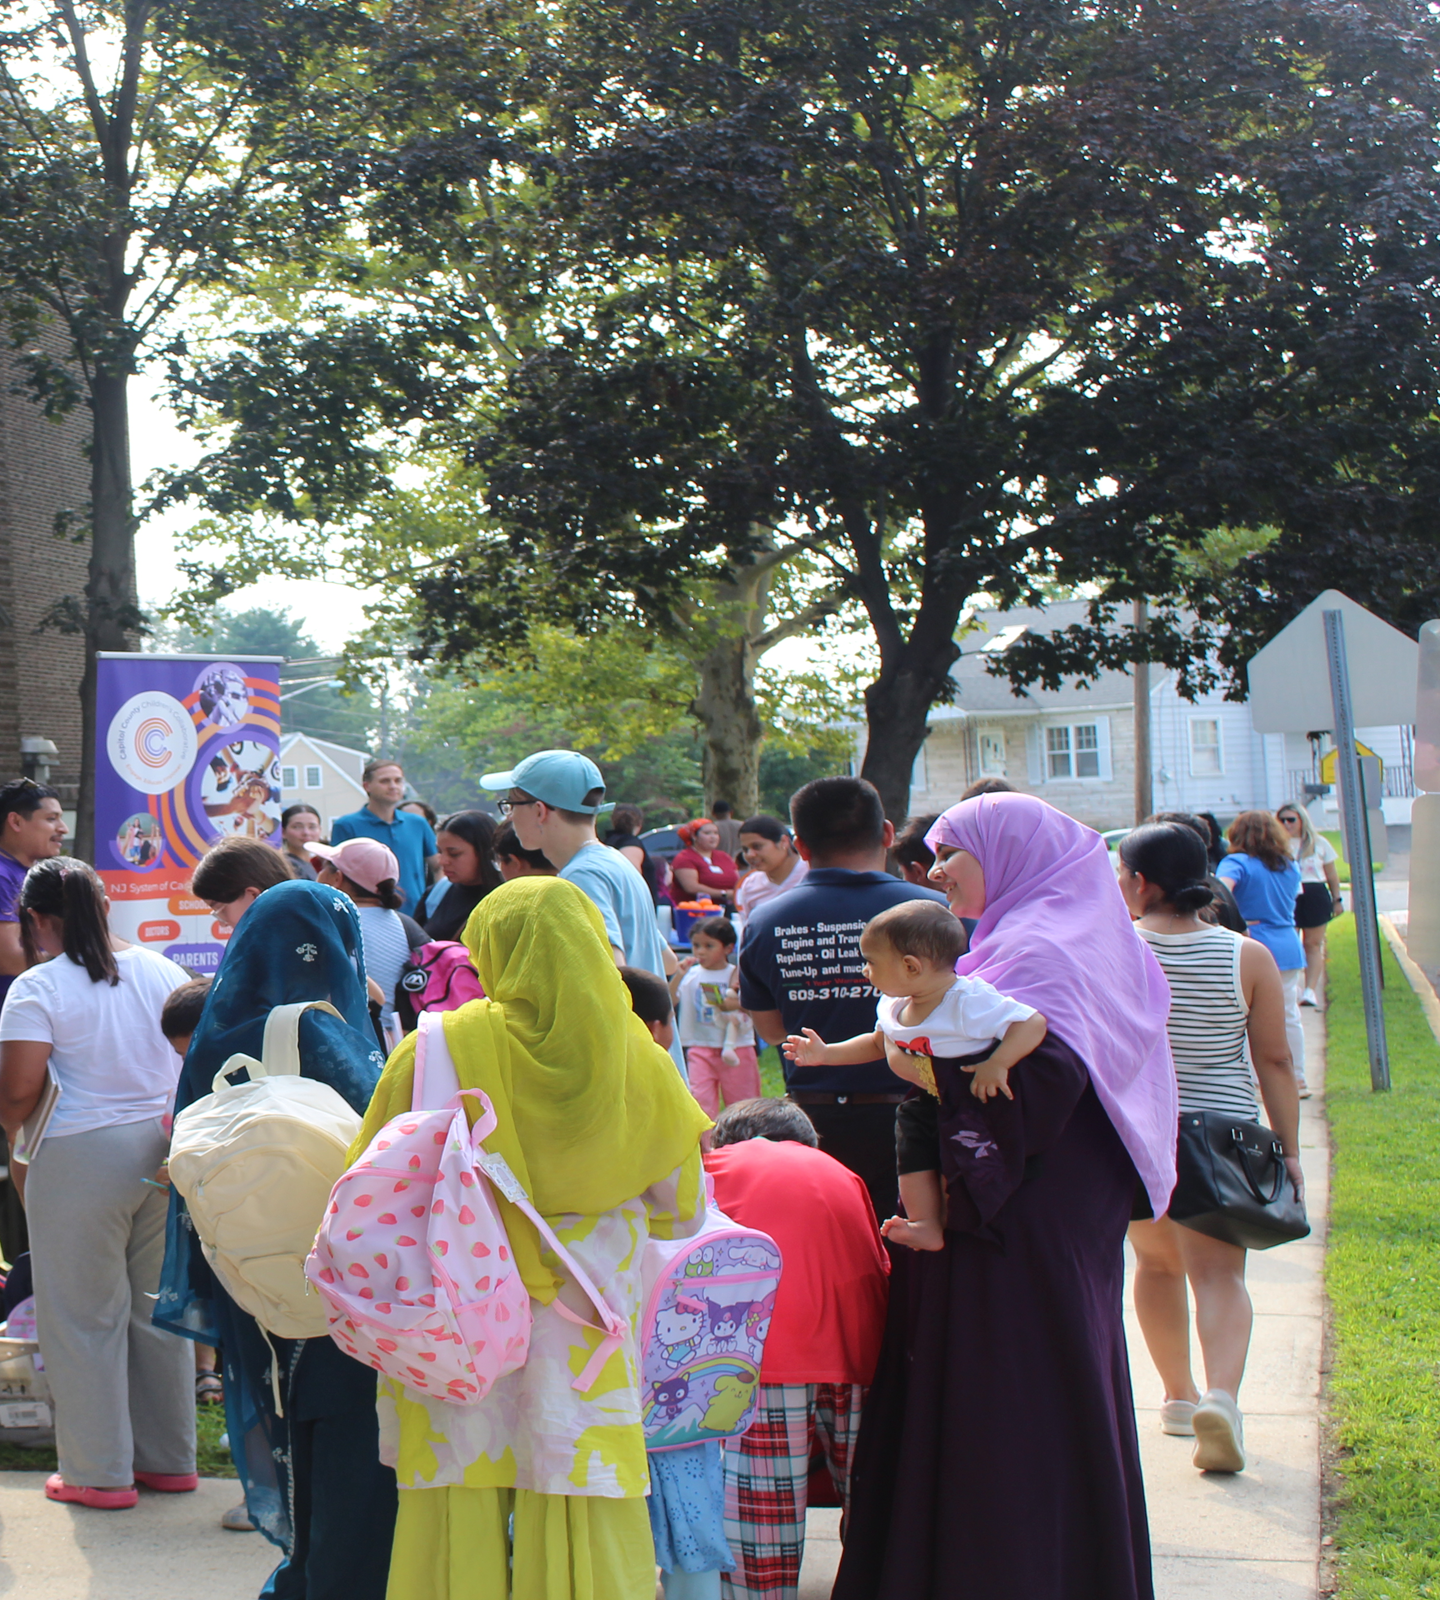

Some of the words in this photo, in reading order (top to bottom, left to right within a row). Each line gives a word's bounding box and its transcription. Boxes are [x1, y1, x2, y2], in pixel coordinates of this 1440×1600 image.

[110, 883, 127, 894] NJ
[129, 883, 159, 895] System
[159, 881, 169, 891] of
[774, 925, 809, 937] Brakes
[817, 919, 868, 934] Suspensio
[781, 936, 814, 951] Engine
[816, 934, 835, 946] and
[173, 951, 219, 966] PARENTS
[776, 952, 813, 965] Replace
[821, 948, 835, 959] Oil
[780, 966, 818, 979] Tune-Up
[822, 963, 841, 975] and
[834, 977, 871, 985] Warrant
